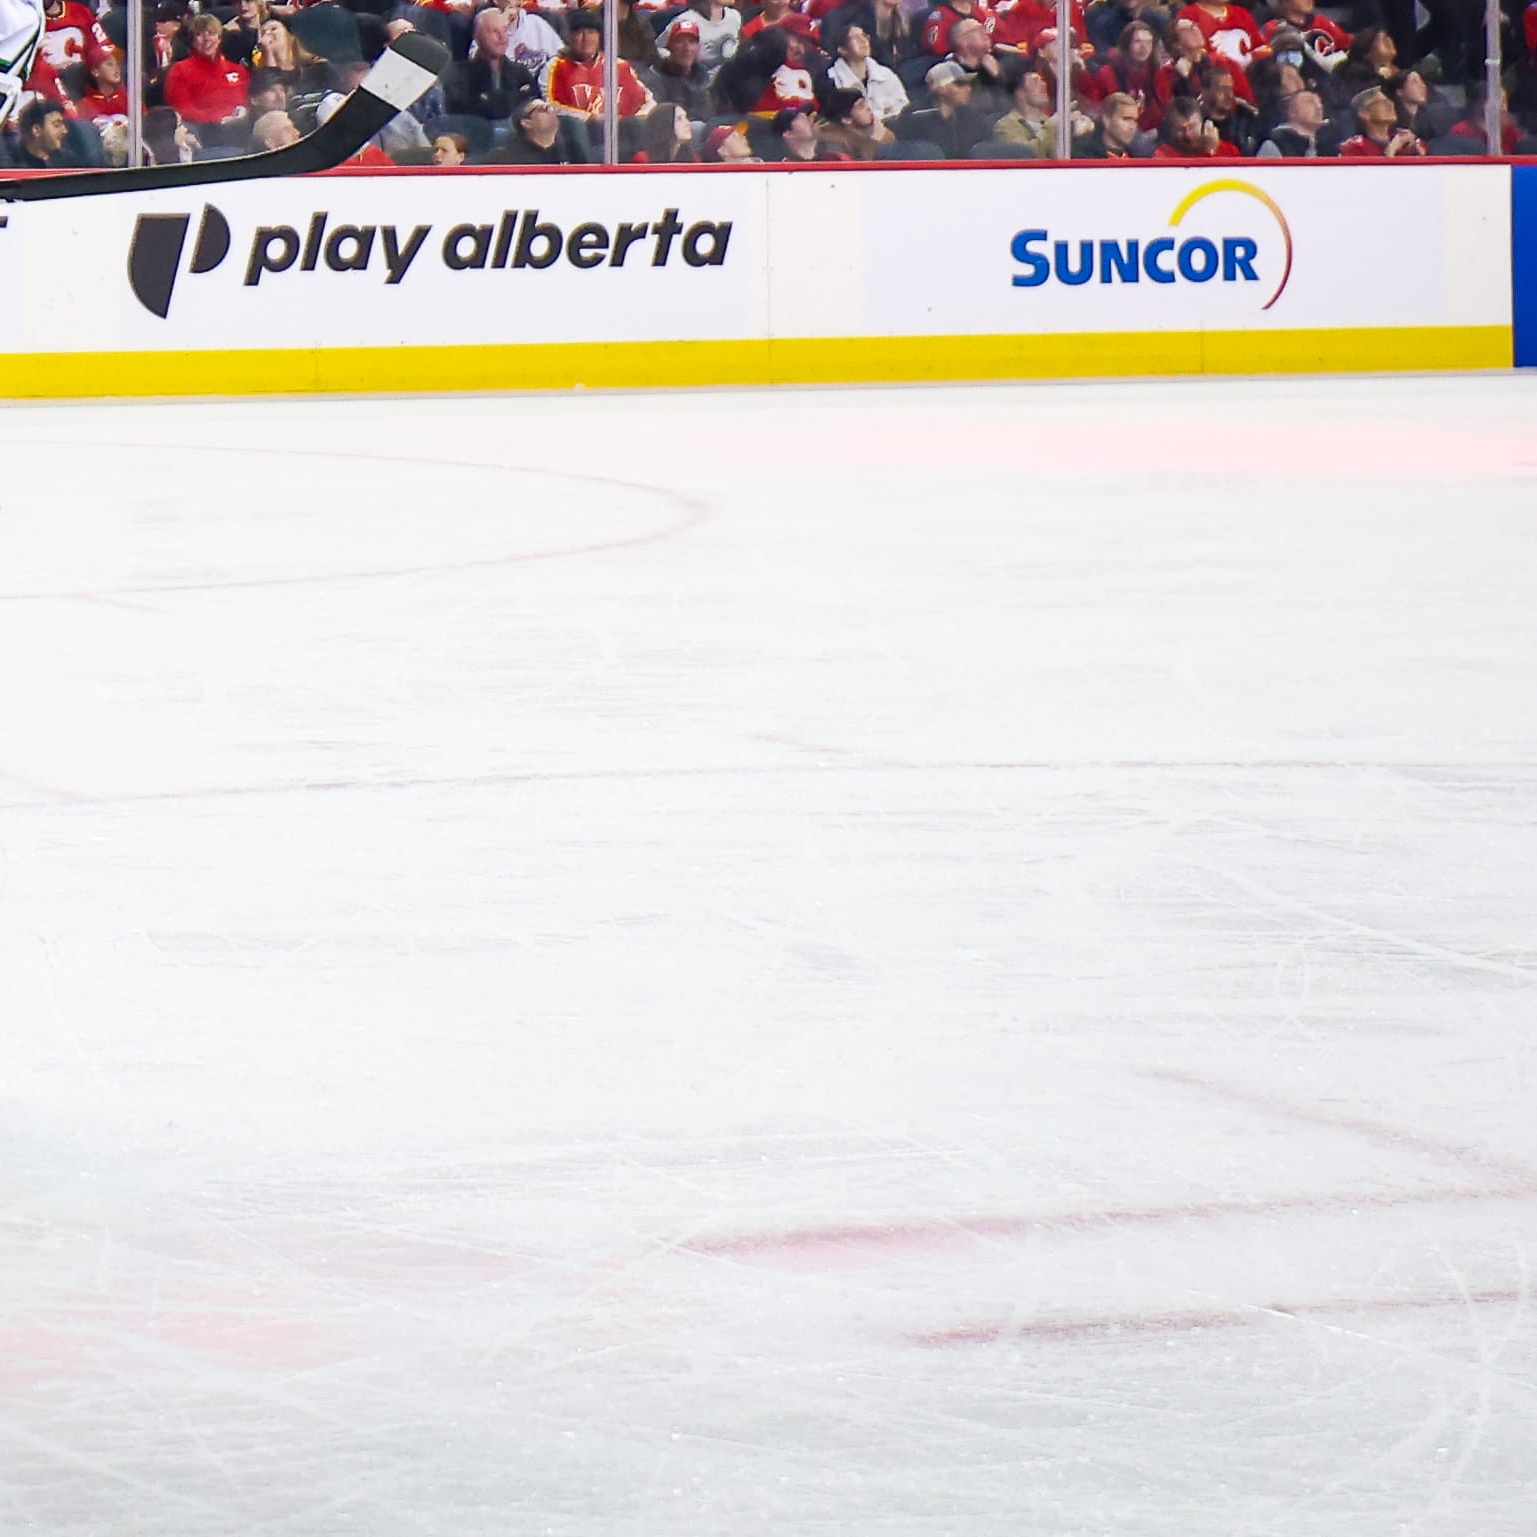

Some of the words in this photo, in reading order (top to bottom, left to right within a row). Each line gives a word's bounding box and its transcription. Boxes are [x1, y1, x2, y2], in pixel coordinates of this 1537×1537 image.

[246, 211, 432, 288] play
[441, 207, 733, 271] alberta
[1010, 228, 1260, 288] SUNCOR
